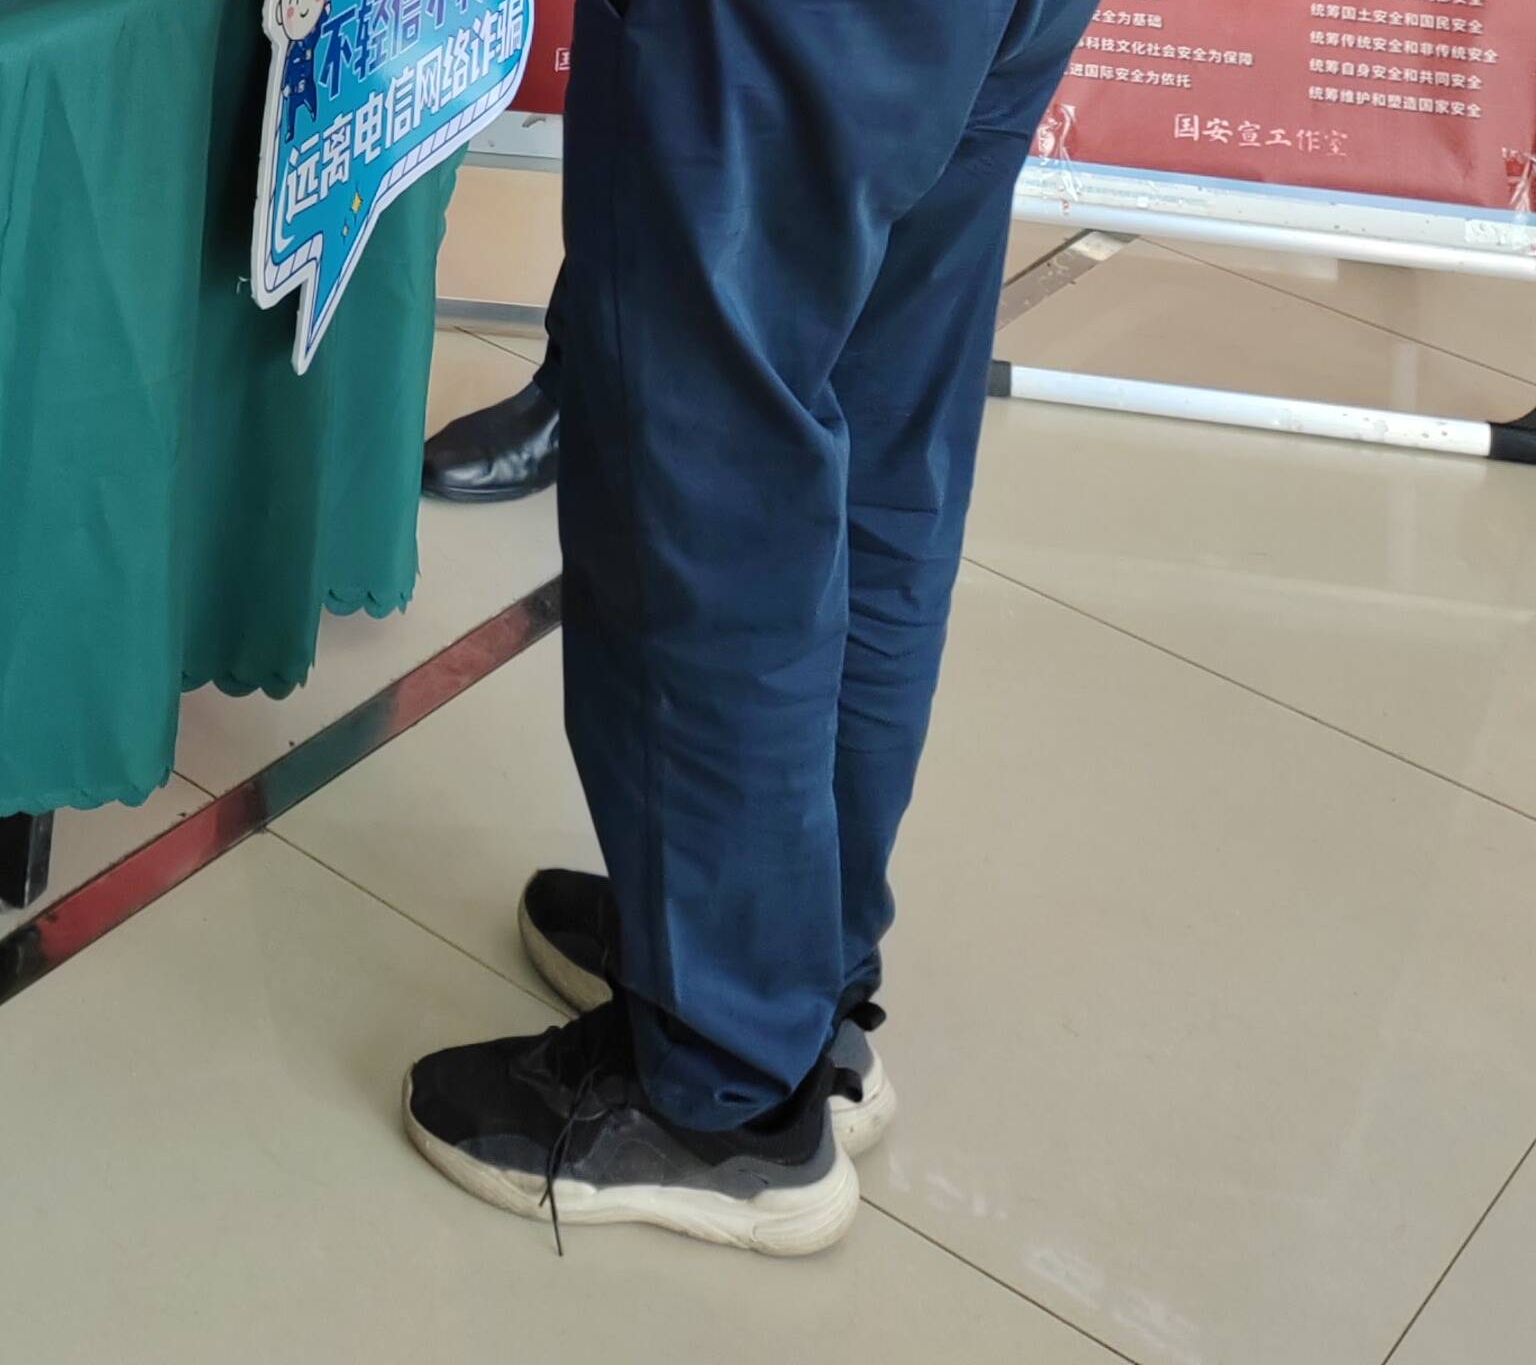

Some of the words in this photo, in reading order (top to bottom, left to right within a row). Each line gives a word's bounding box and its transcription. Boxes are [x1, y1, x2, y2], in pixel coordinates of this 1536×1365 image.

[1310, 3, 1484, 35] 统筹国土安全和国民安全
[1309, 30, 1499, 64] 统筹传统安全和非传统安全
[1064, 63, 1192, 89] 进国际安全为依托
[1308, 57, 1483, 90] 统筹自身安全和共同安全
[1308, 85, 1482, 119] 统筹维护和塑造国家安全
[1174, 113, 1349, 157] 国安宣工作室
